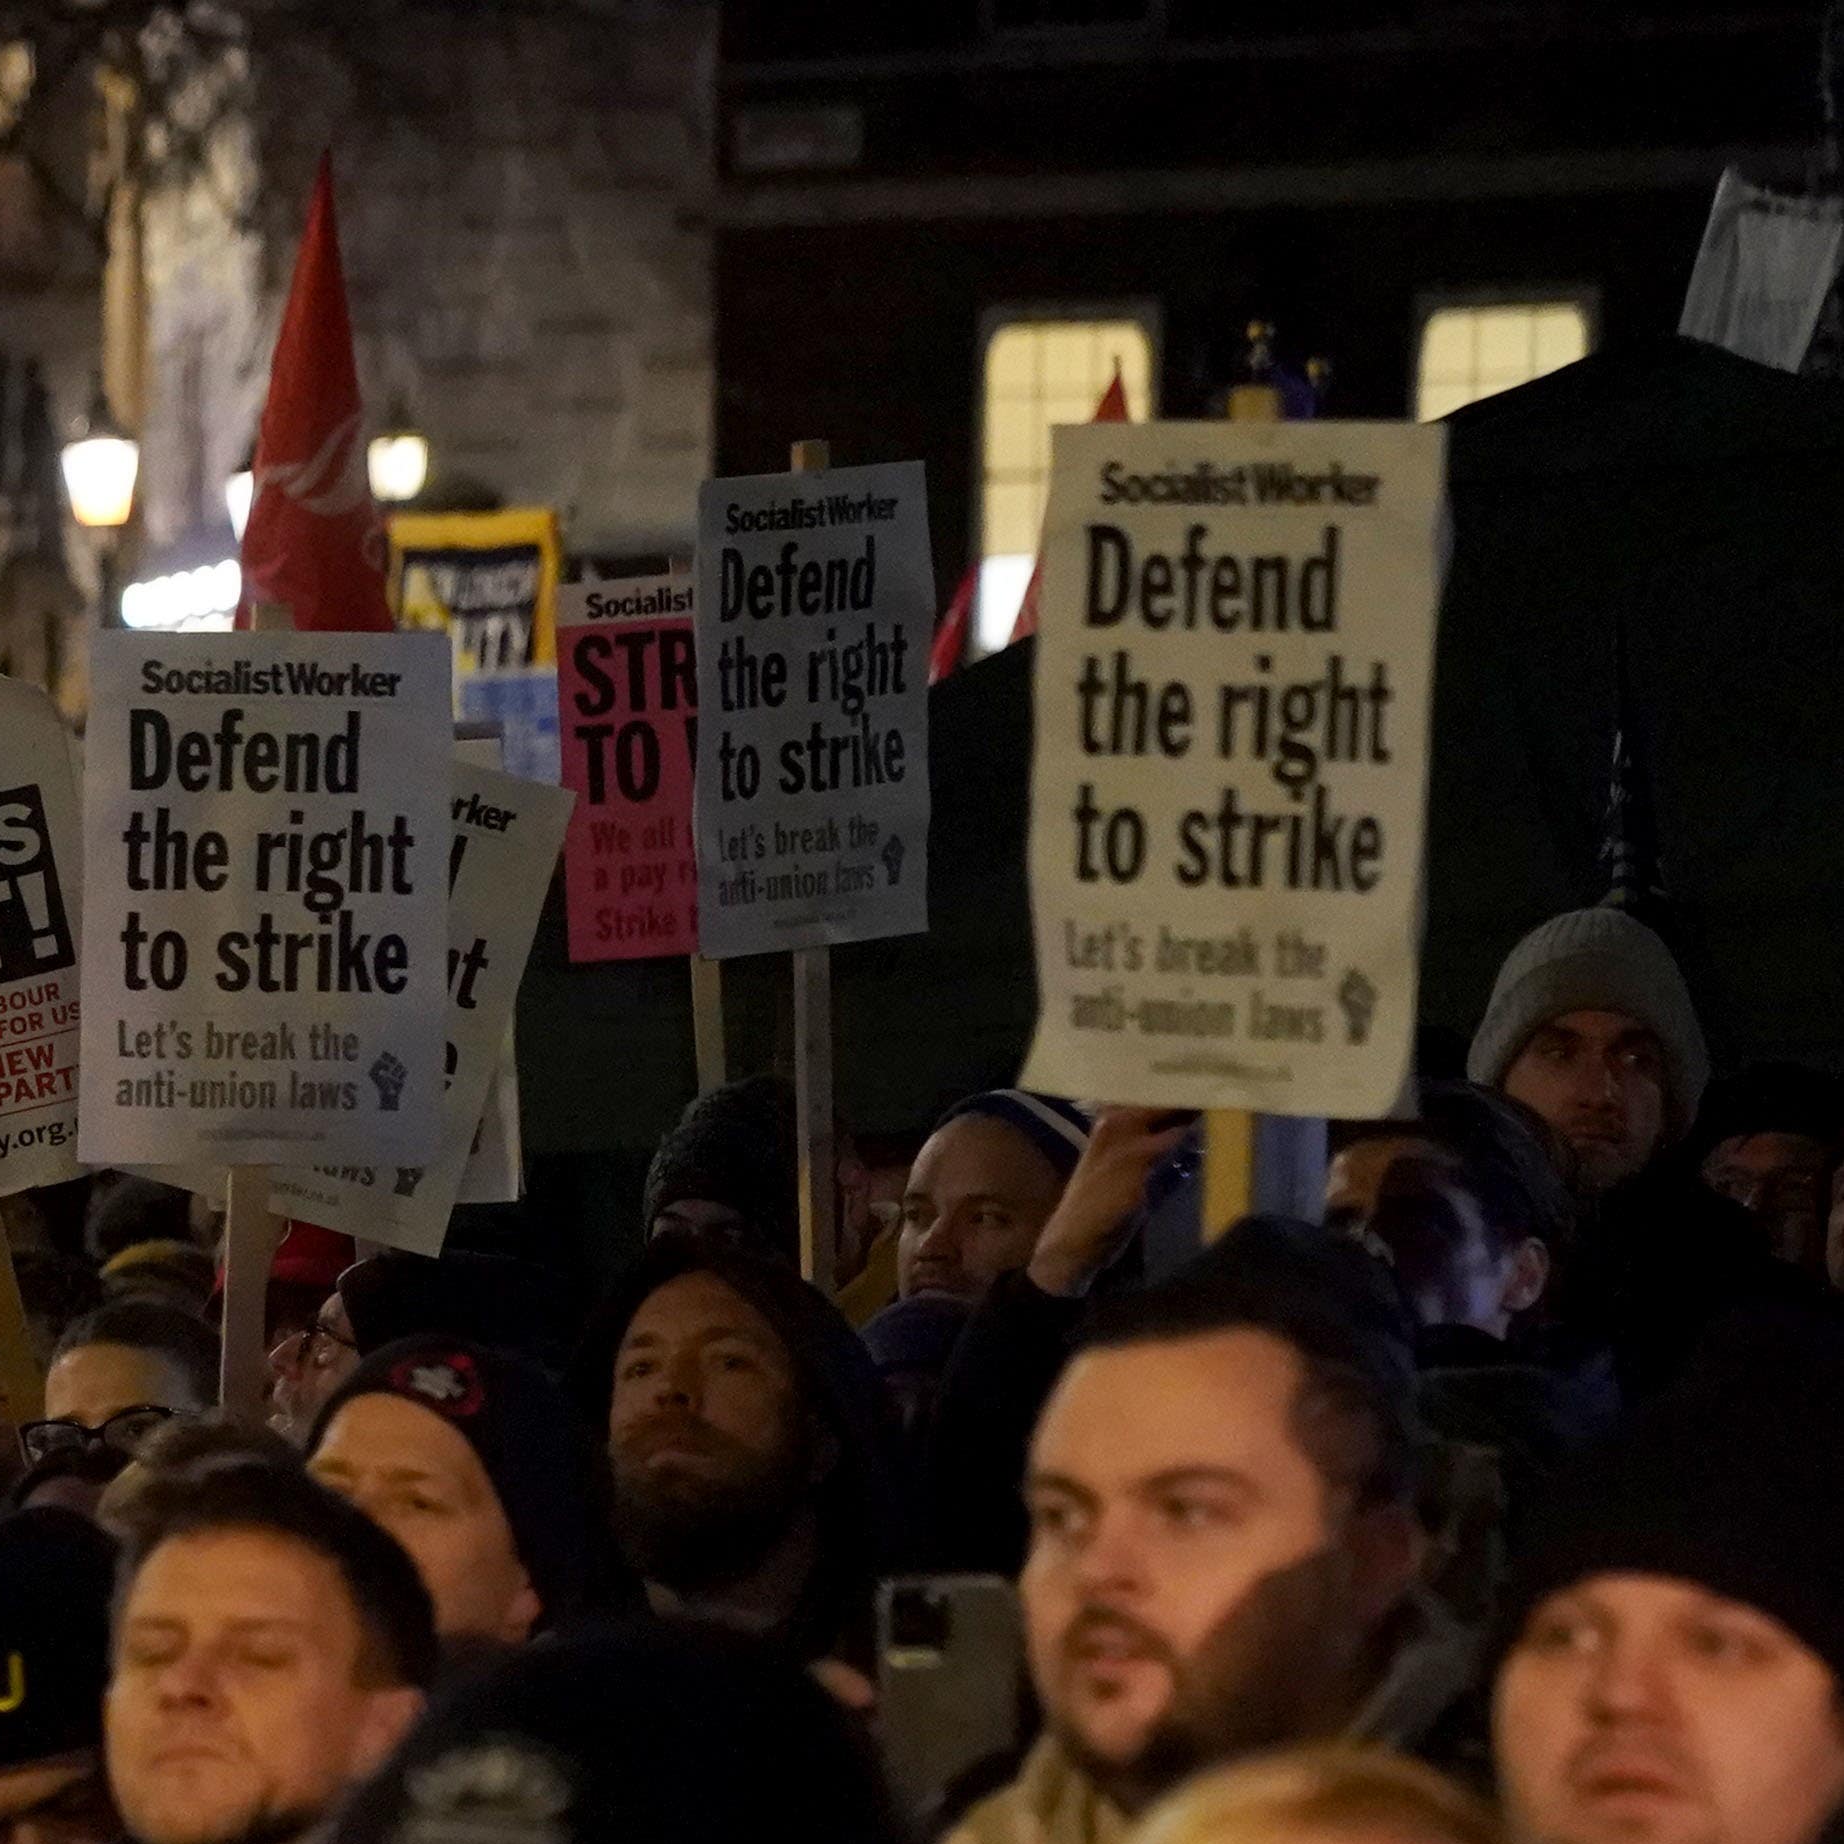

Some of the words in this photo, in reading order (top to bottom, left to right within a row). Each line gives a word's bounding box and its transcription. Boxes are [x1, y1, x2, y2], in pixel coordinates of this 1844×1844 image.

[725, 499, 825, 535] Socialist
[827, 493, 899, 526] Worker
[720, 535, 875, 622] Defend
[1082, 524, 1341, 633] Defend
[141, 660, 283, 695] Socialist
[286, 663, 401, 698] Worker
[718, 635, 786, 714] the
[807, 622, 909, 717] right
[1077, 650, 1194, 757] the
[1219, 654, 1396, 801] right
[129, 708, 361, 794] Defend
[575, 721, 660, 804] TO
[720, 731, 760, 800] to
[779, 711, 905, 797] strike
[451, 793, 516, 832] rker
[590, 821, 631, 854] We
[644, 817, 674, 849] all
[123, 806, 229, 893] the
[256, 810, 414, 913] right
[719, 822, 765, 863] Let's
[775, 819, 841, 857] break
[849, 815, 879, 847] the
[1074, 783, 1148, 884] to
[1175, 787, 1385, 894] strike
[595, 868, 608, 891] a
[621, 860, 665, 896] pay
[719, 867, 831, 908] anti-union
[836, 860, 874, 896] laws
[596, 908, 675, 942] Strike
[120, 912, 188, 993] to
[216, 909, 408, 996] strike
[51, 1001, 80, 1025] US
[117, 1020, 192, 1060] Let's
[206, 1021, 295, 1061] break
[310, 1022, 360, 1062] the
[115, 1072, 278, 1111] anti-union
[289, 1074, 358, 1112] laws
